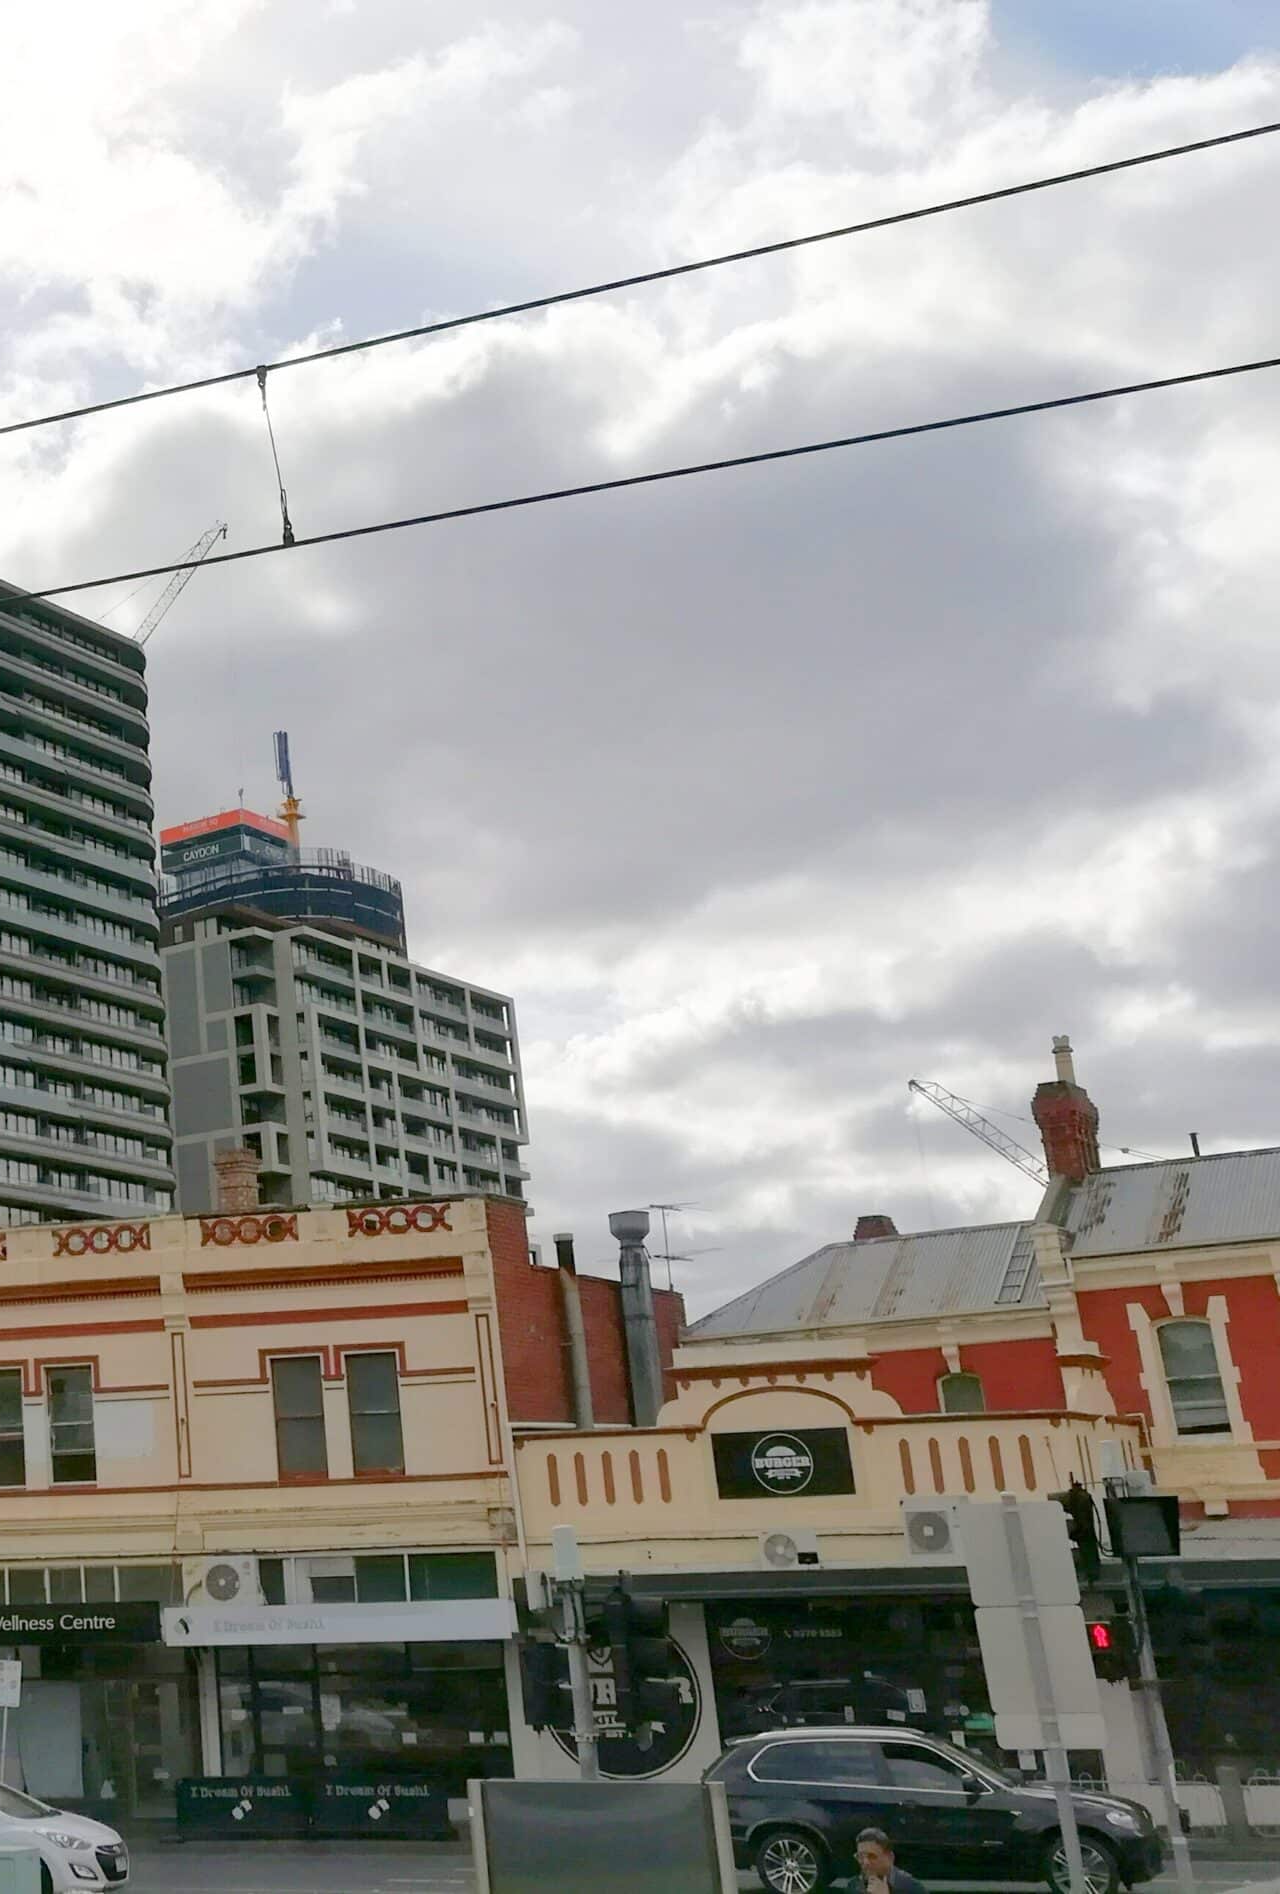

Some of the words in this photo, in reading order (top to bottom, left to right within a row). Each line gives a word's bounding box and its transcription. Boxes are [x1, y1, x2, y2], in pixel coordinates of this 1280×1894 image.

[183, 843, 220, 862] CAYDON
[754, 1456, 811, 1469] BURGER
[59, 1614, 116, 1631] Centre
[201, 1786, 238, 1798] Dream
[240, 1785, 253, 1797] Of
[335, 1785, 375, 1797] Dream
[377, 1785, 391, 1797] Of
[394, 1785, 430, 1797] Sushi
